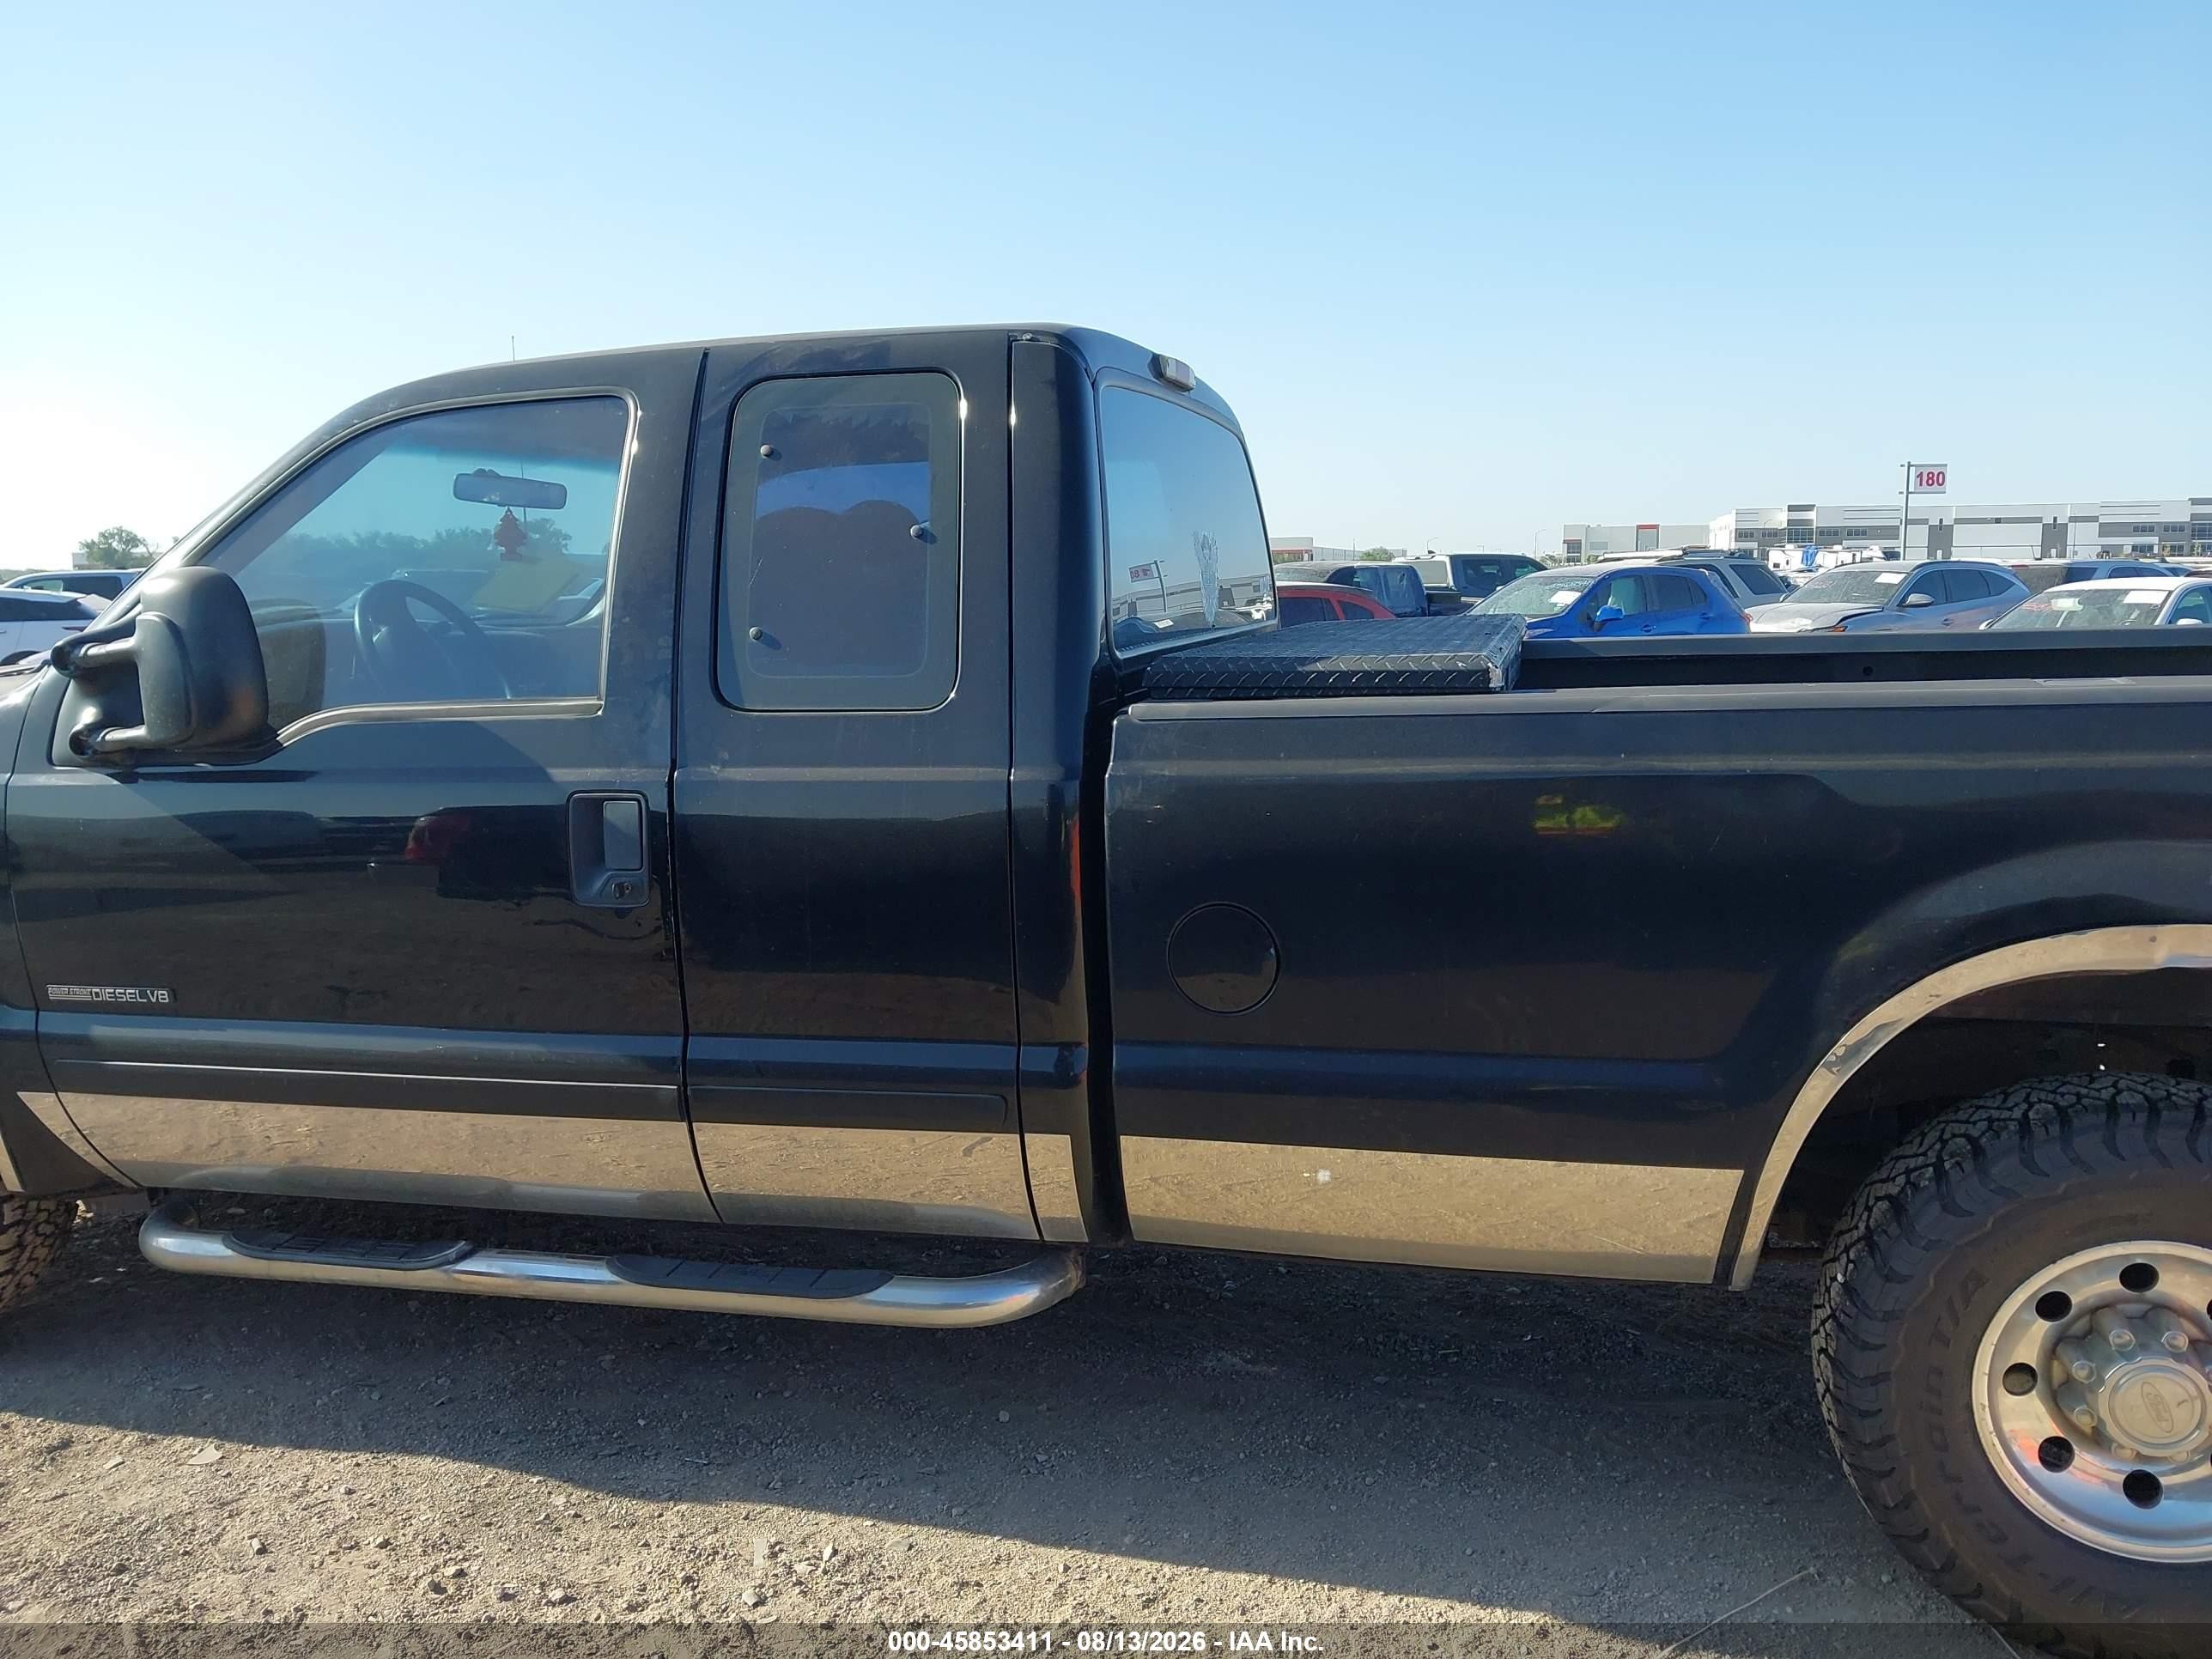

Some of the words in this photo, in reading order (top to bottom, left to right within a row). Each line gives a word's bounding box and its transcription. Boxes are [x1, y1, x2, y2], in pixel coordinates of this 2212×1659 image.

[1916, 471, 1946, 487] 180
[69, 988, 92, 996] STROKE
[92, 988, 147, 1002] DIESEL
[147, 990, 169, 1003] V8
[1923, 1267, 1992, 1350] T/A
[2145, 1389, 2172, 1424] Ford
